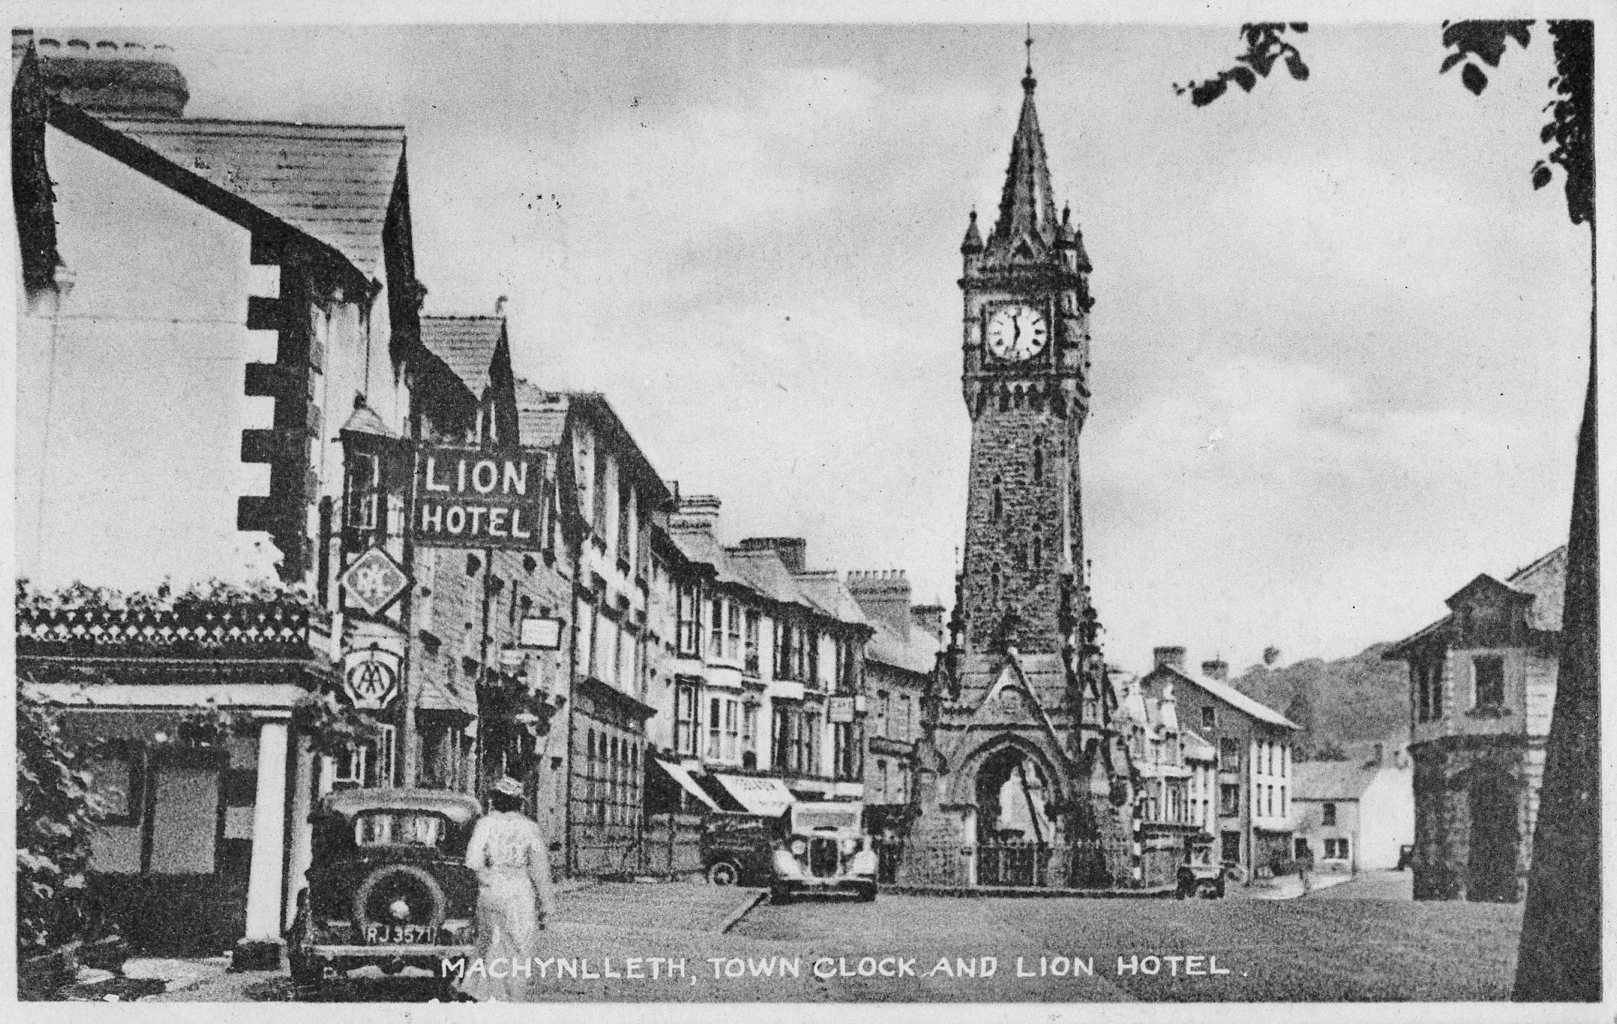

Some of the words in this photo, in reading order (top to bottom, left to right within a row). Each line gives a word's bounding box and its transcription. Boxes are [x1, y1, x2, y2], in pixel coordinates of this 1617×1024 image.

[425, 456, 528, 495] LION
[421, 504, 531, 539] HOTEL
[356, 663, 385, 694] AA
[367, 926, 390, 944] RJ
[393, 925, 431, 944] 3571
